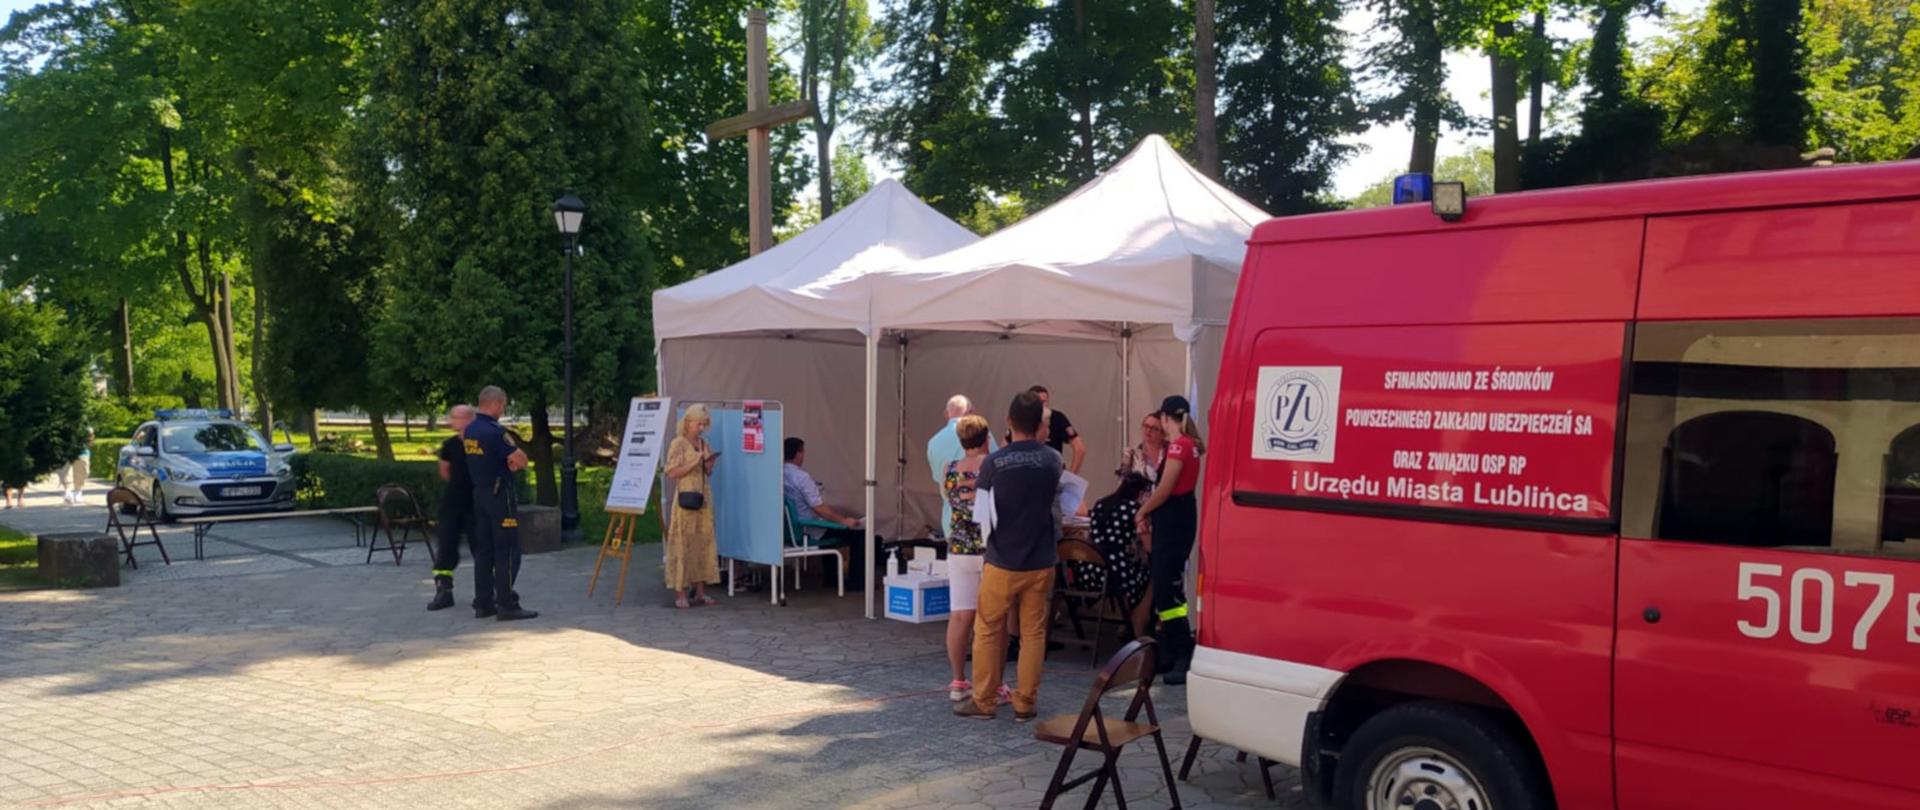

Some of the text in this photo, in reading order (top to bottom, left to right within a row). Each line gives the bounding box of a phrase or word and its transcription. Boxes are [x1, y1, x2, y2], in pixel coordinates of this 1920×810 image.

[1384, 366, 1554, 391] SFINANSOWANO ZE ŚRODKÓW
[1275, 383, 1318, 432] PZU
[1345, 408, 1592, 435] POWSZECHNEGO ZAKŁADU UBEZPIECZEŃ SA
[1393, 450, 1527, 475] ORAZ ZWIĄZKU OSP RP
[1292, 470, 1588, 512] i Urzędu Miasta Lublińca
[1737, 561, 1895, 651] 507
